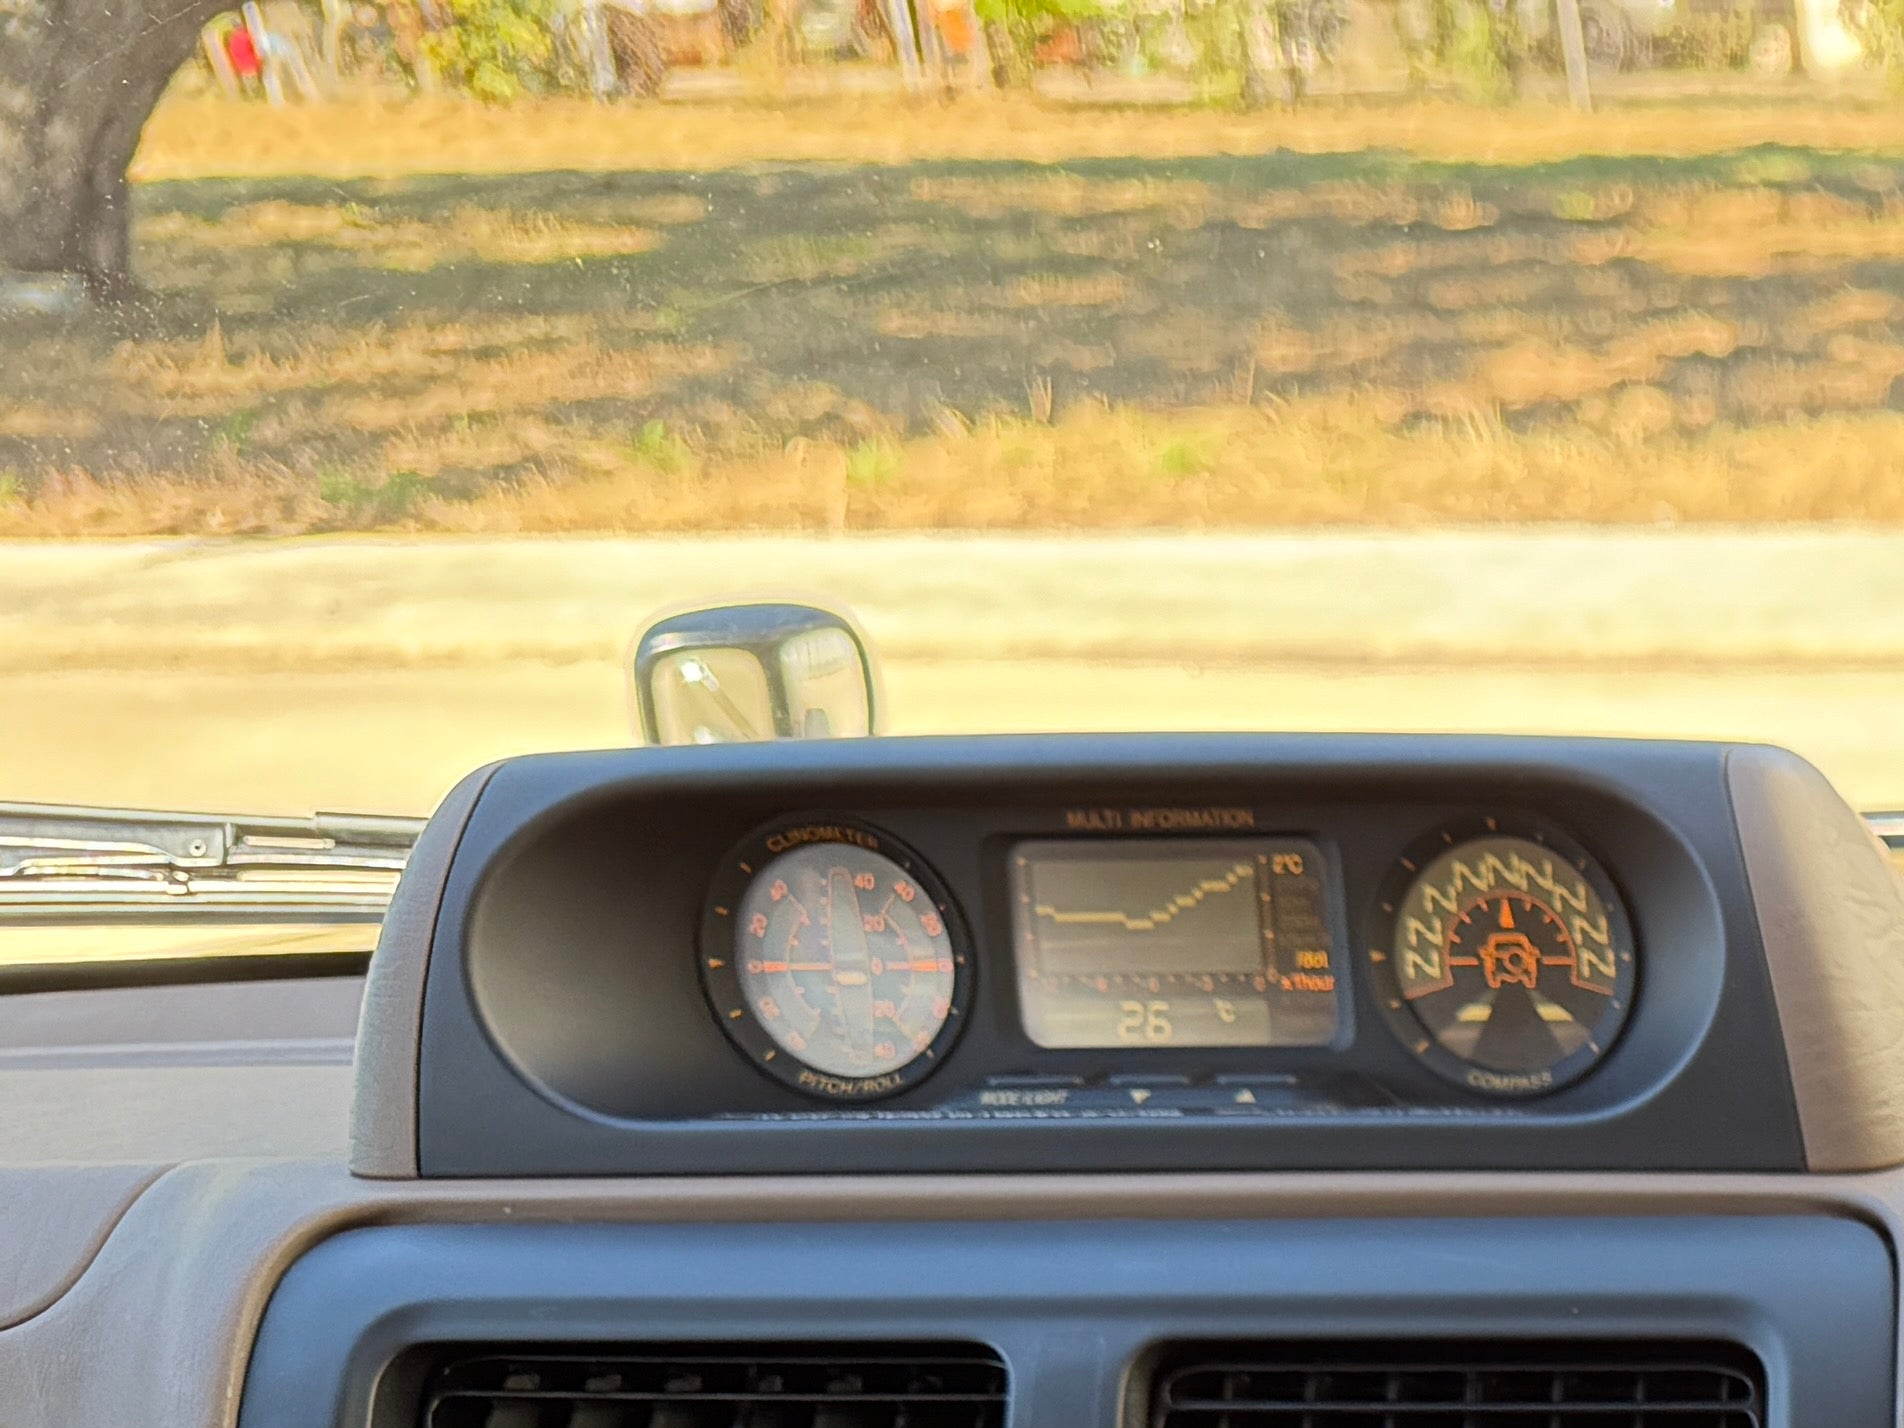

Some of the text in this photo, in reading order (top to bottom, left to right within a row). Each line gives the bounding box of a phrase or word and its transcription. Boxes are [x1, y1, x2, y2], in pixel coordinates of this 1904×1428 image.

[1066, 808, 1255, 830] MULTI INFORMATION
[767, 825, 879, 853] CLINOMETER
[1117, 1000, 1175, 1044] 26
